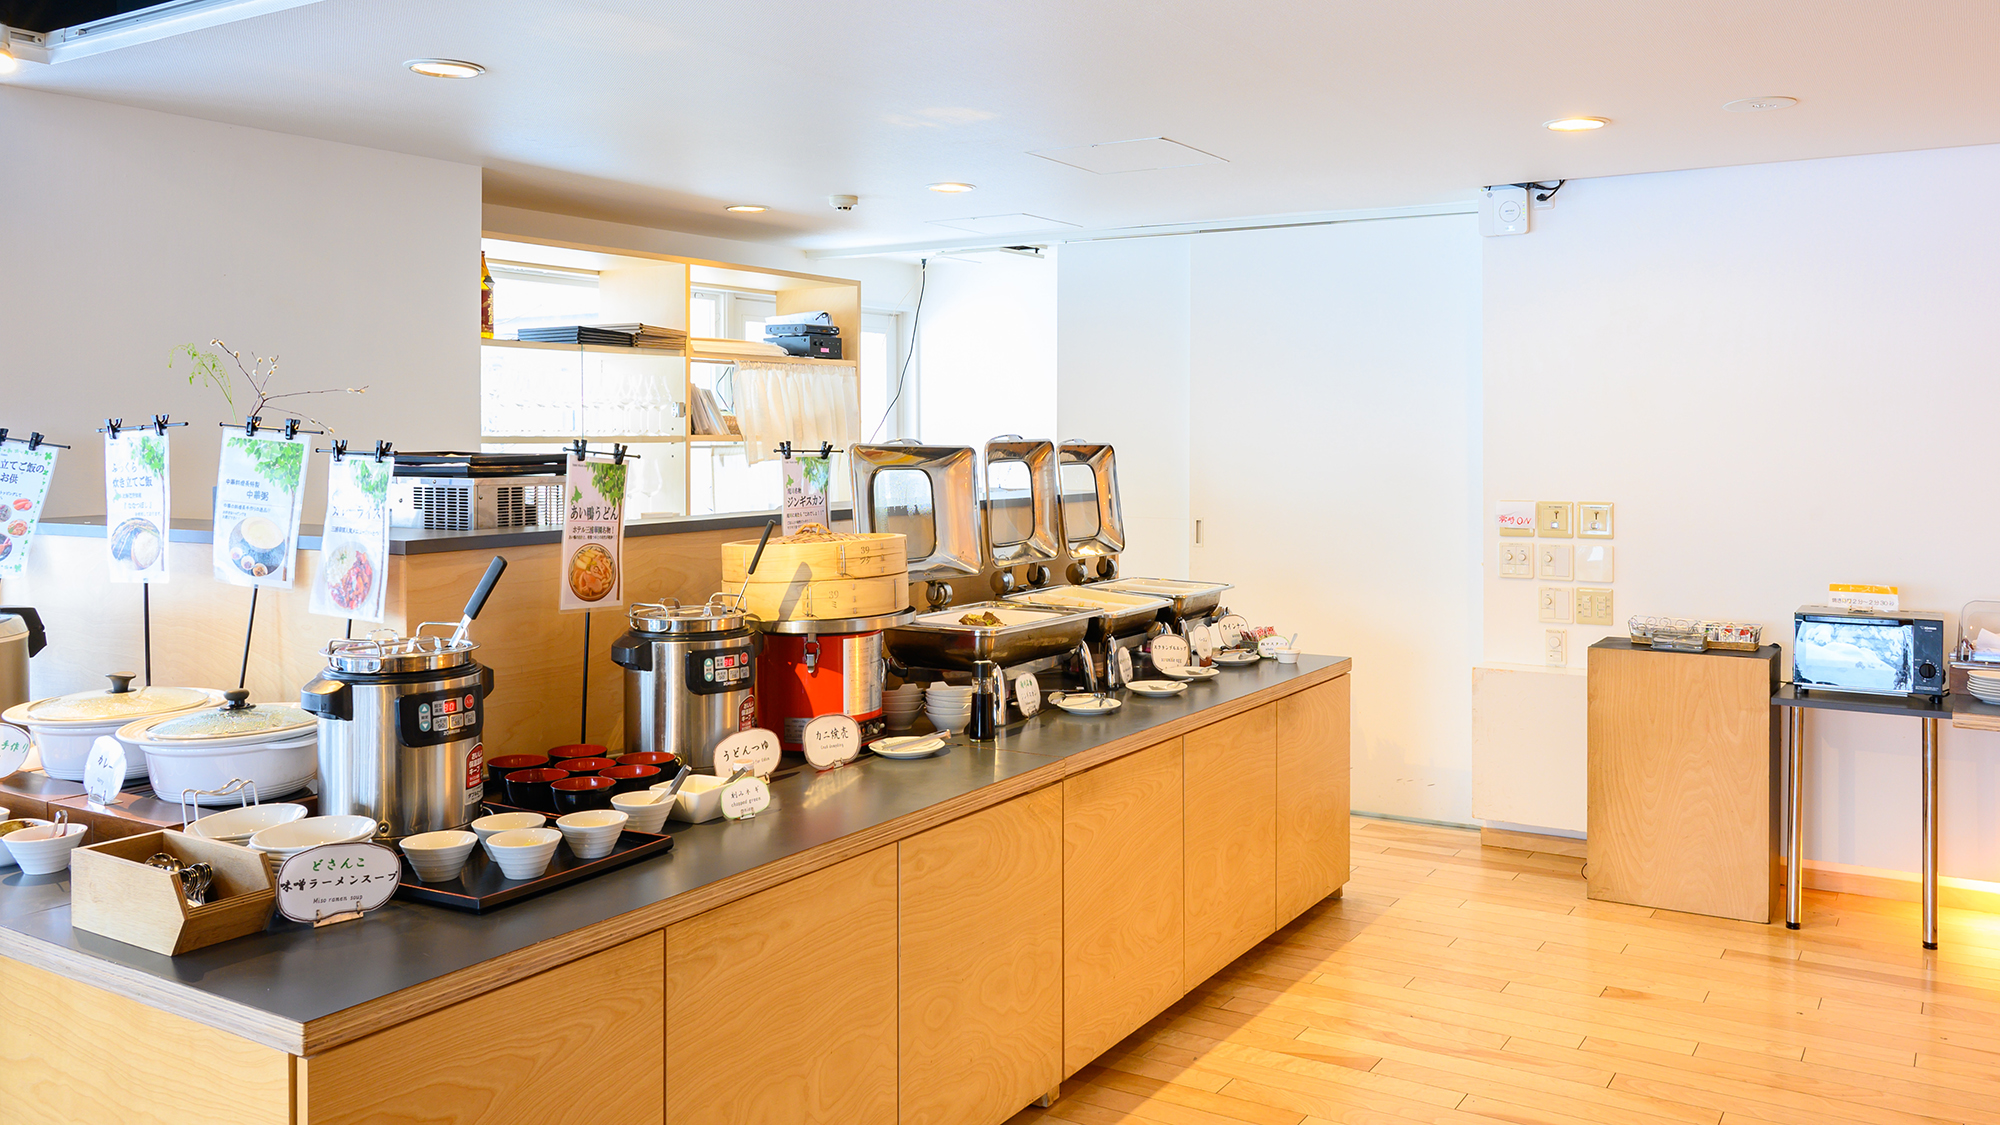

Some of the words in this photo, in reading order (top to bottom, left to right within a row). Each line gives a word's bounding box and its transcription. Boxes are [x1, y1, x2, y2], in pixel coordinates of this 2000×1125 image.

[112, 475, 153, 488] 炊き立てご飯
[246, 490, 269, 502] 中華粥
[787, 495, 825, 508] ジンギスカン
[570, 505, 619, 520] あい鴨うどん
[1849, 585, 1879, 593] トースト
[816, 726, 849, 741] カニ焼売
[1, 739, 29, 754] 手作り
[723, 740, 769, 762] うどんつゆ
[97, 754, 114, 769] カレー
[731, 785, 760, 799] 刻みネギ
[312, 857, 365, 872] どさんこ
[280, 870, 399, 893] 味噌ラーメンスープ
